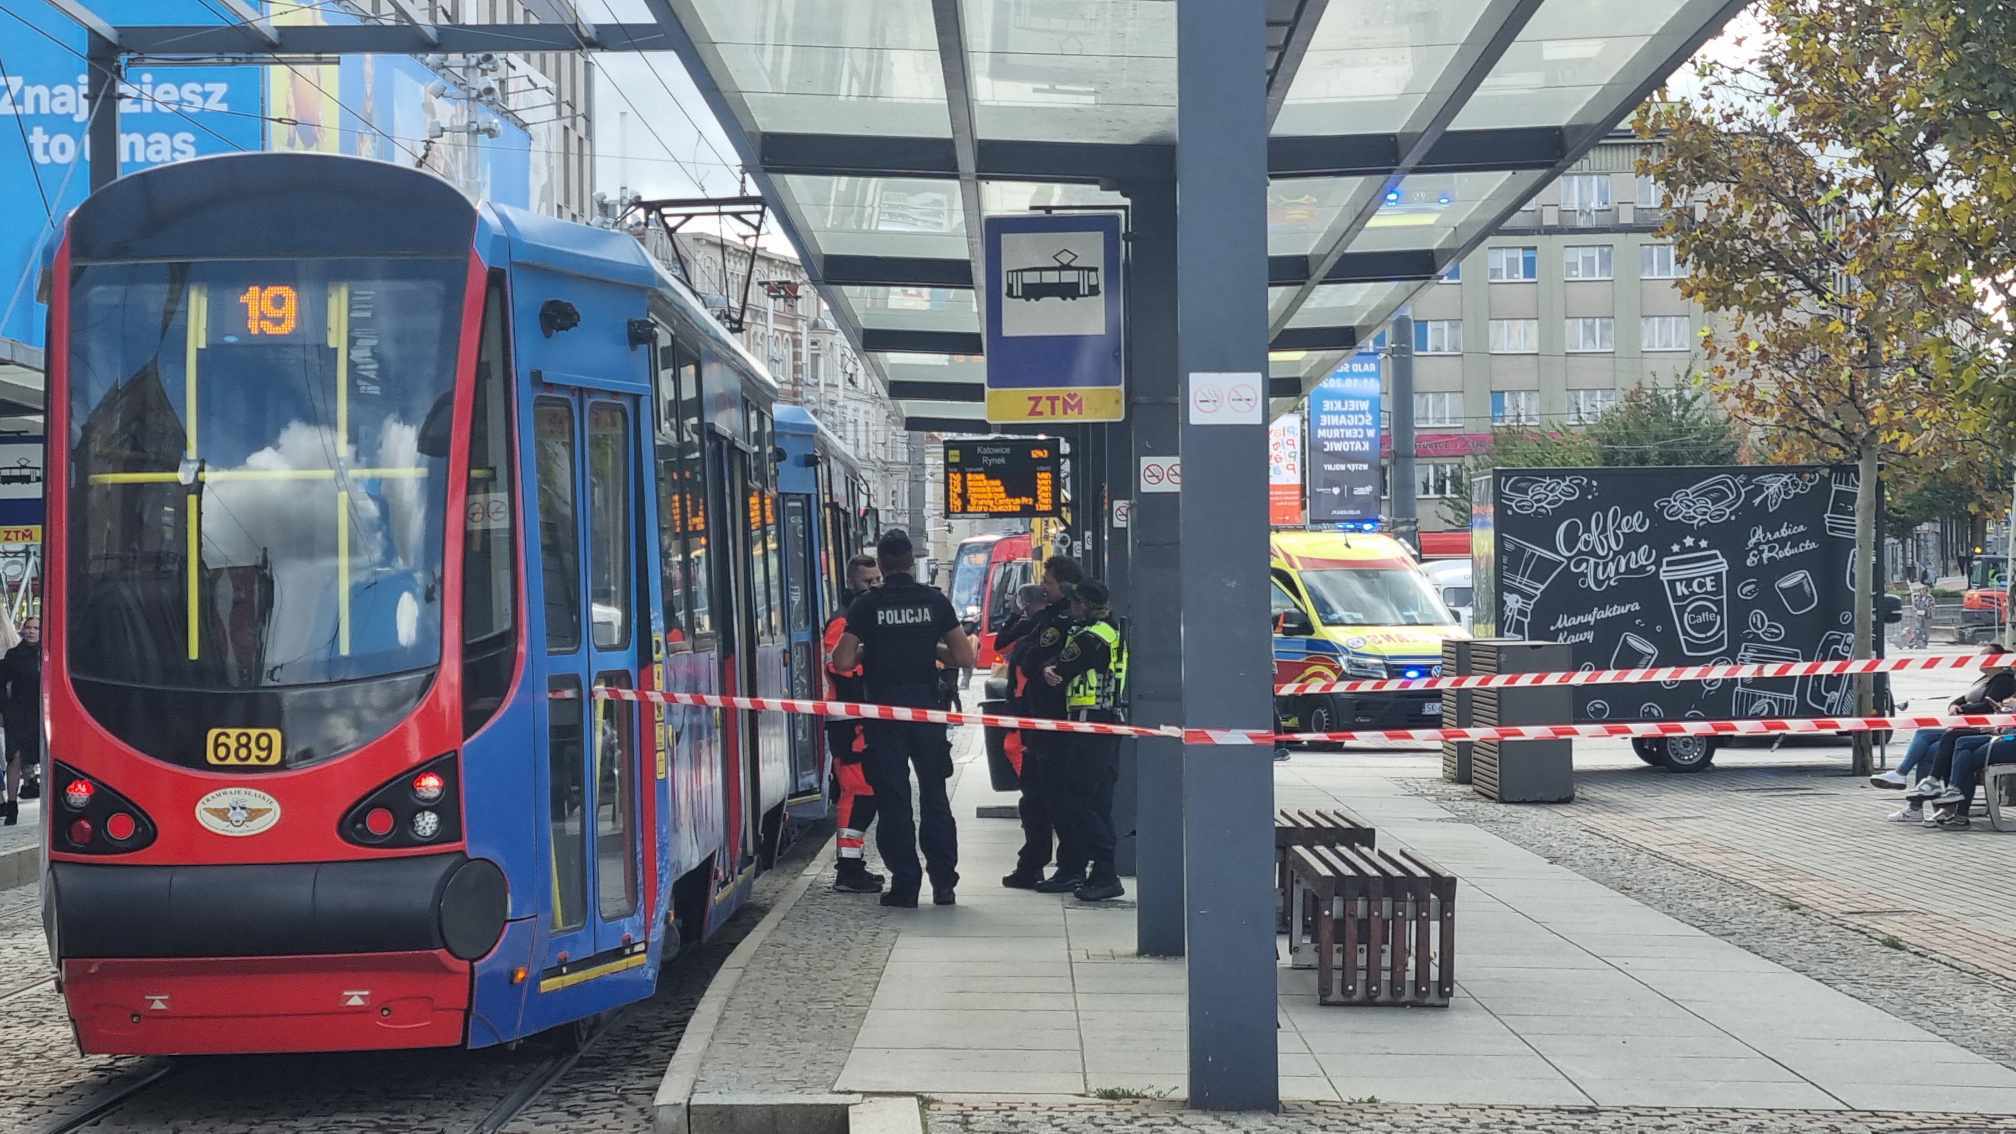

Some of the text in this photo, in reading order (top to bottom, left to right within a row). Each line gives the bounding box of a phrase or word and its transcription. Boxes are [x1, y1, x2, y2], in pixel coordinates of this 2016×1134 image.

[0, 73, 229, 122] Znajziesz
[29, 126, 75, 164] to
[120, 131, 197, 163] nas
[239, 286, 297, 336] 19
[1027, 392, 1084, 417] ZTM
[982, 456, 1006, 465] Rynek
[3, 528, 33, 541] ZTM
[1556, 505, 1650, 556] Coffee
[1745, 522, 1807, 550] Arabica
[1570, 545, 1656, 591] Time
[877, 607, 931, 625] POLICJA
[1550, 601, 1641, 631] Manufaktura
[1556, 631, 1594, 644] Kawy
[213, 731, 273, 762] 689
